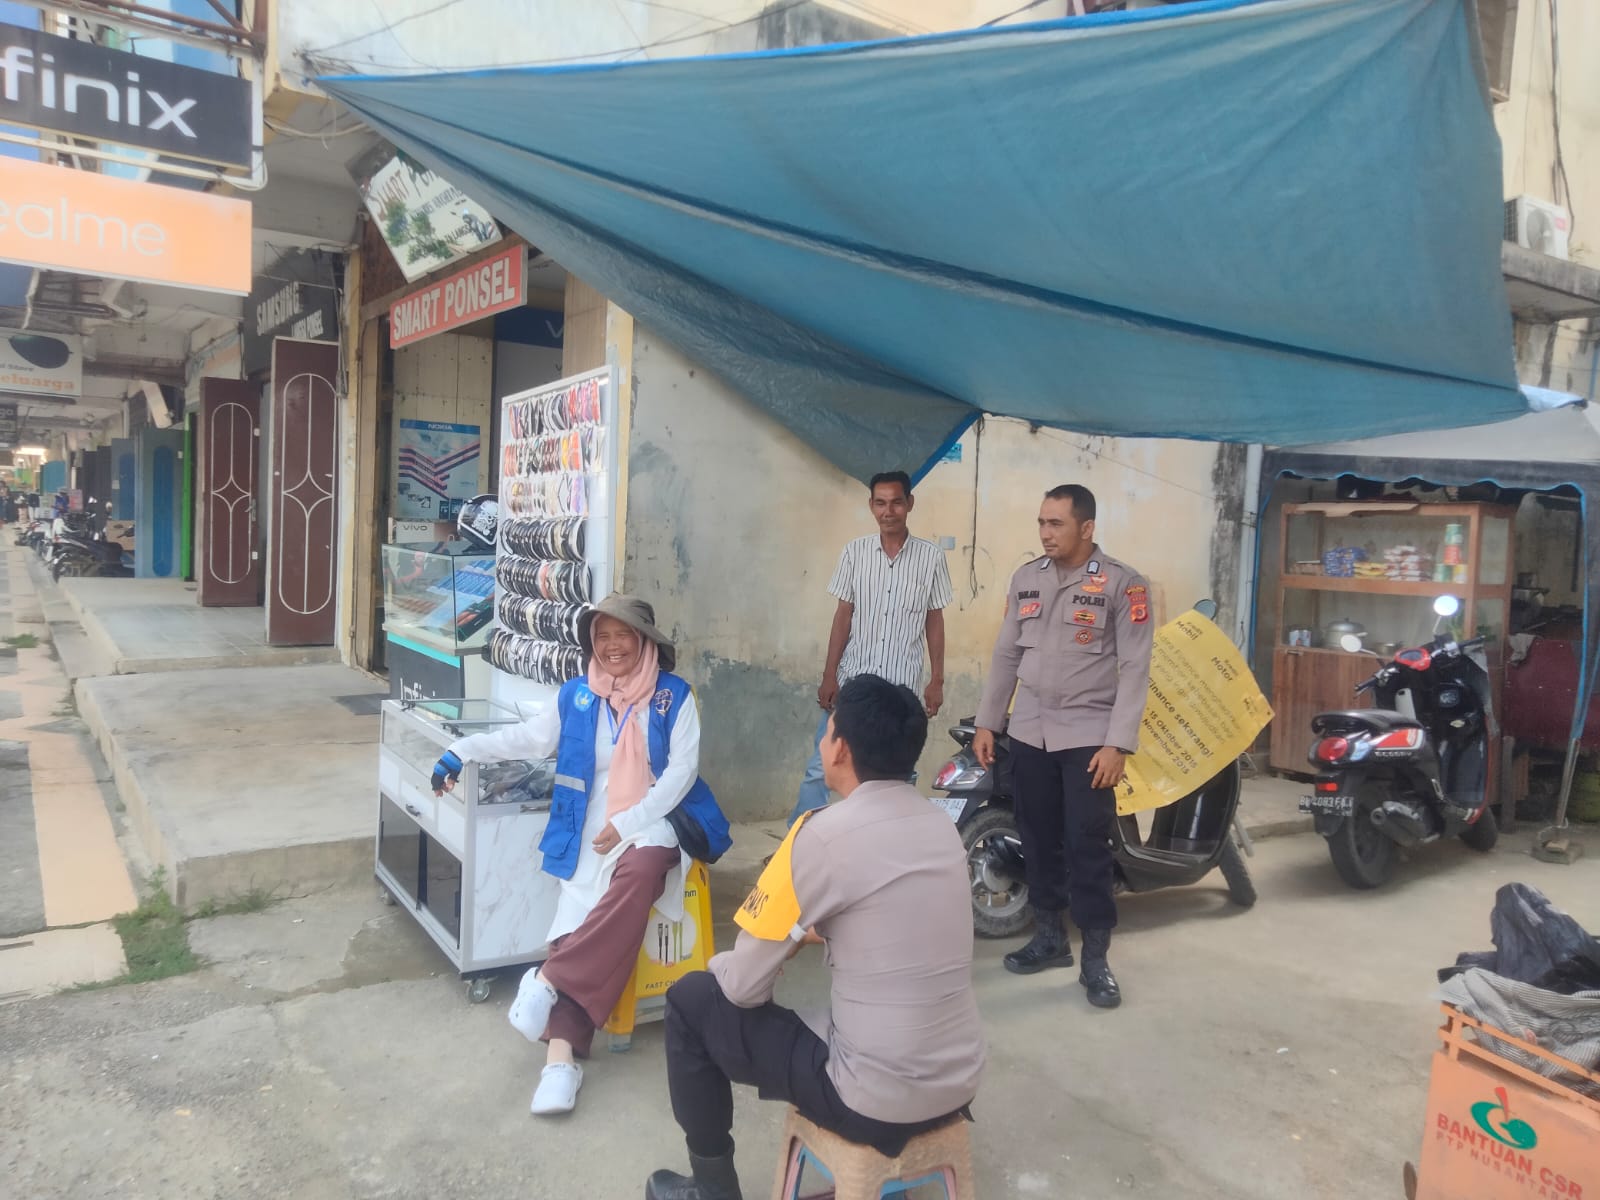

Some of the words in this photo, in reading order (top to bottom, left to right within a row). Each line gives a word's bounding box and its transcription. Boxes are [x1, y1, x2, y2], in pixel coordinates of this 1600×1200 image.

[256, 281, 303, 336] SAMSUNG
[393, 287, 441, 341] SMART
[443, 256, 515, 323] PONSEL
[428, 422, 453, 431] NOKIA
[1072, 594, 1106, 607] POLRI
[1176, 621, 1199, 641] Mobil
[1211, 656, 1233, 681] Motor
[1142, 719, 1174, 757] November
[1156, 720, 1182, 749] Oktober
[1174, 713, 1214, 758] sekarang!
[1437, 1112, 1533, 1176] BANTUAN
[1539, 1167, 1584, 1200] CSR
